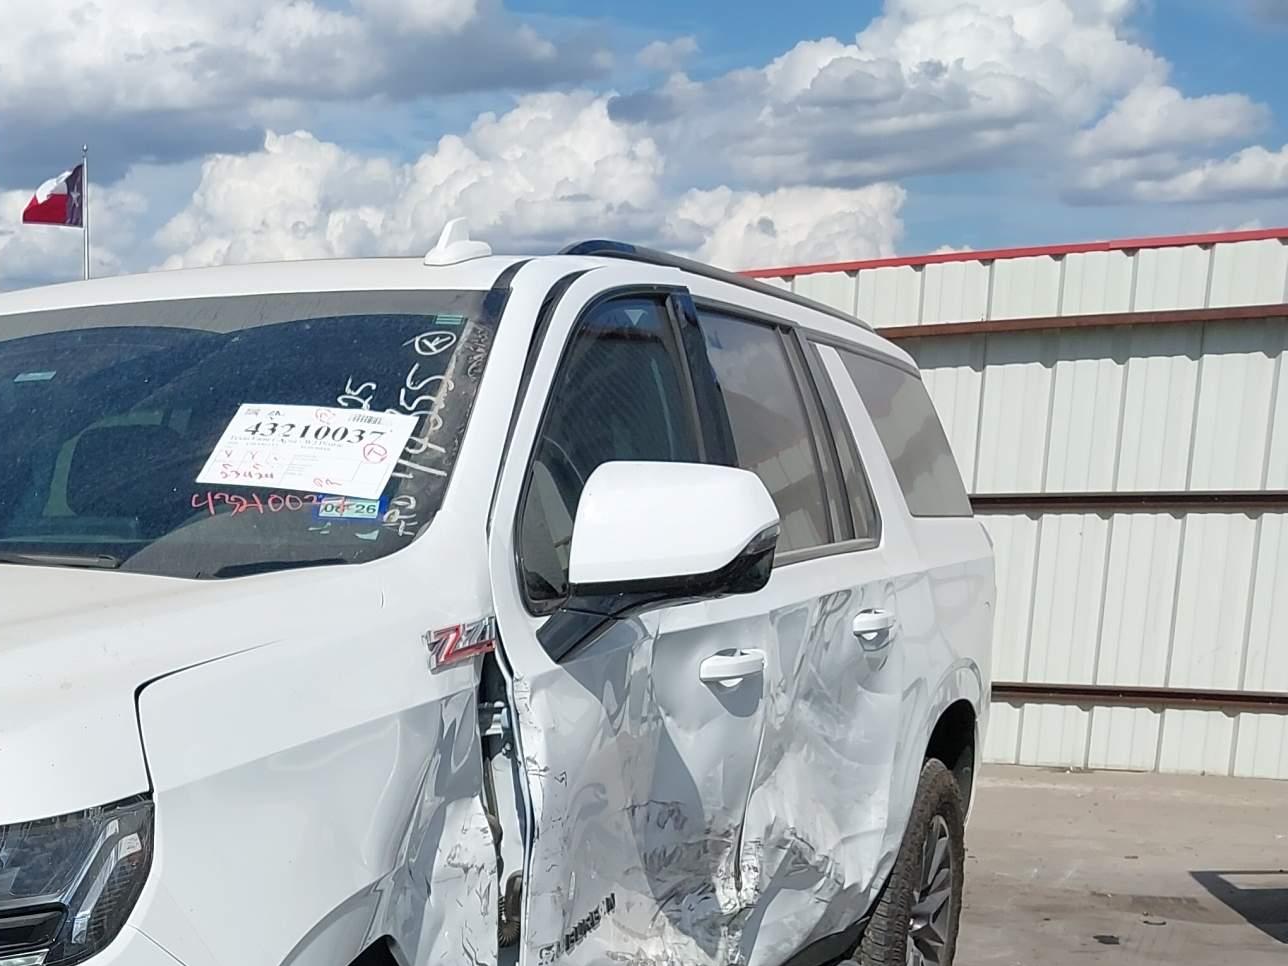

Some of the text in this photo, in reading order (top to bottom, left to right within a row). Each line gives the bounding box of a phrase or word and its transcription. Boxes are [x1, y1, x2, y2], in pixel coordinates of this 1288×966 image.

[244, 421, 387, 444] 43210037
[355, 504, 376, 514] 26
[425, 616, 495, 674] Z71
[538, 893, 616, 966] SUBURBN
